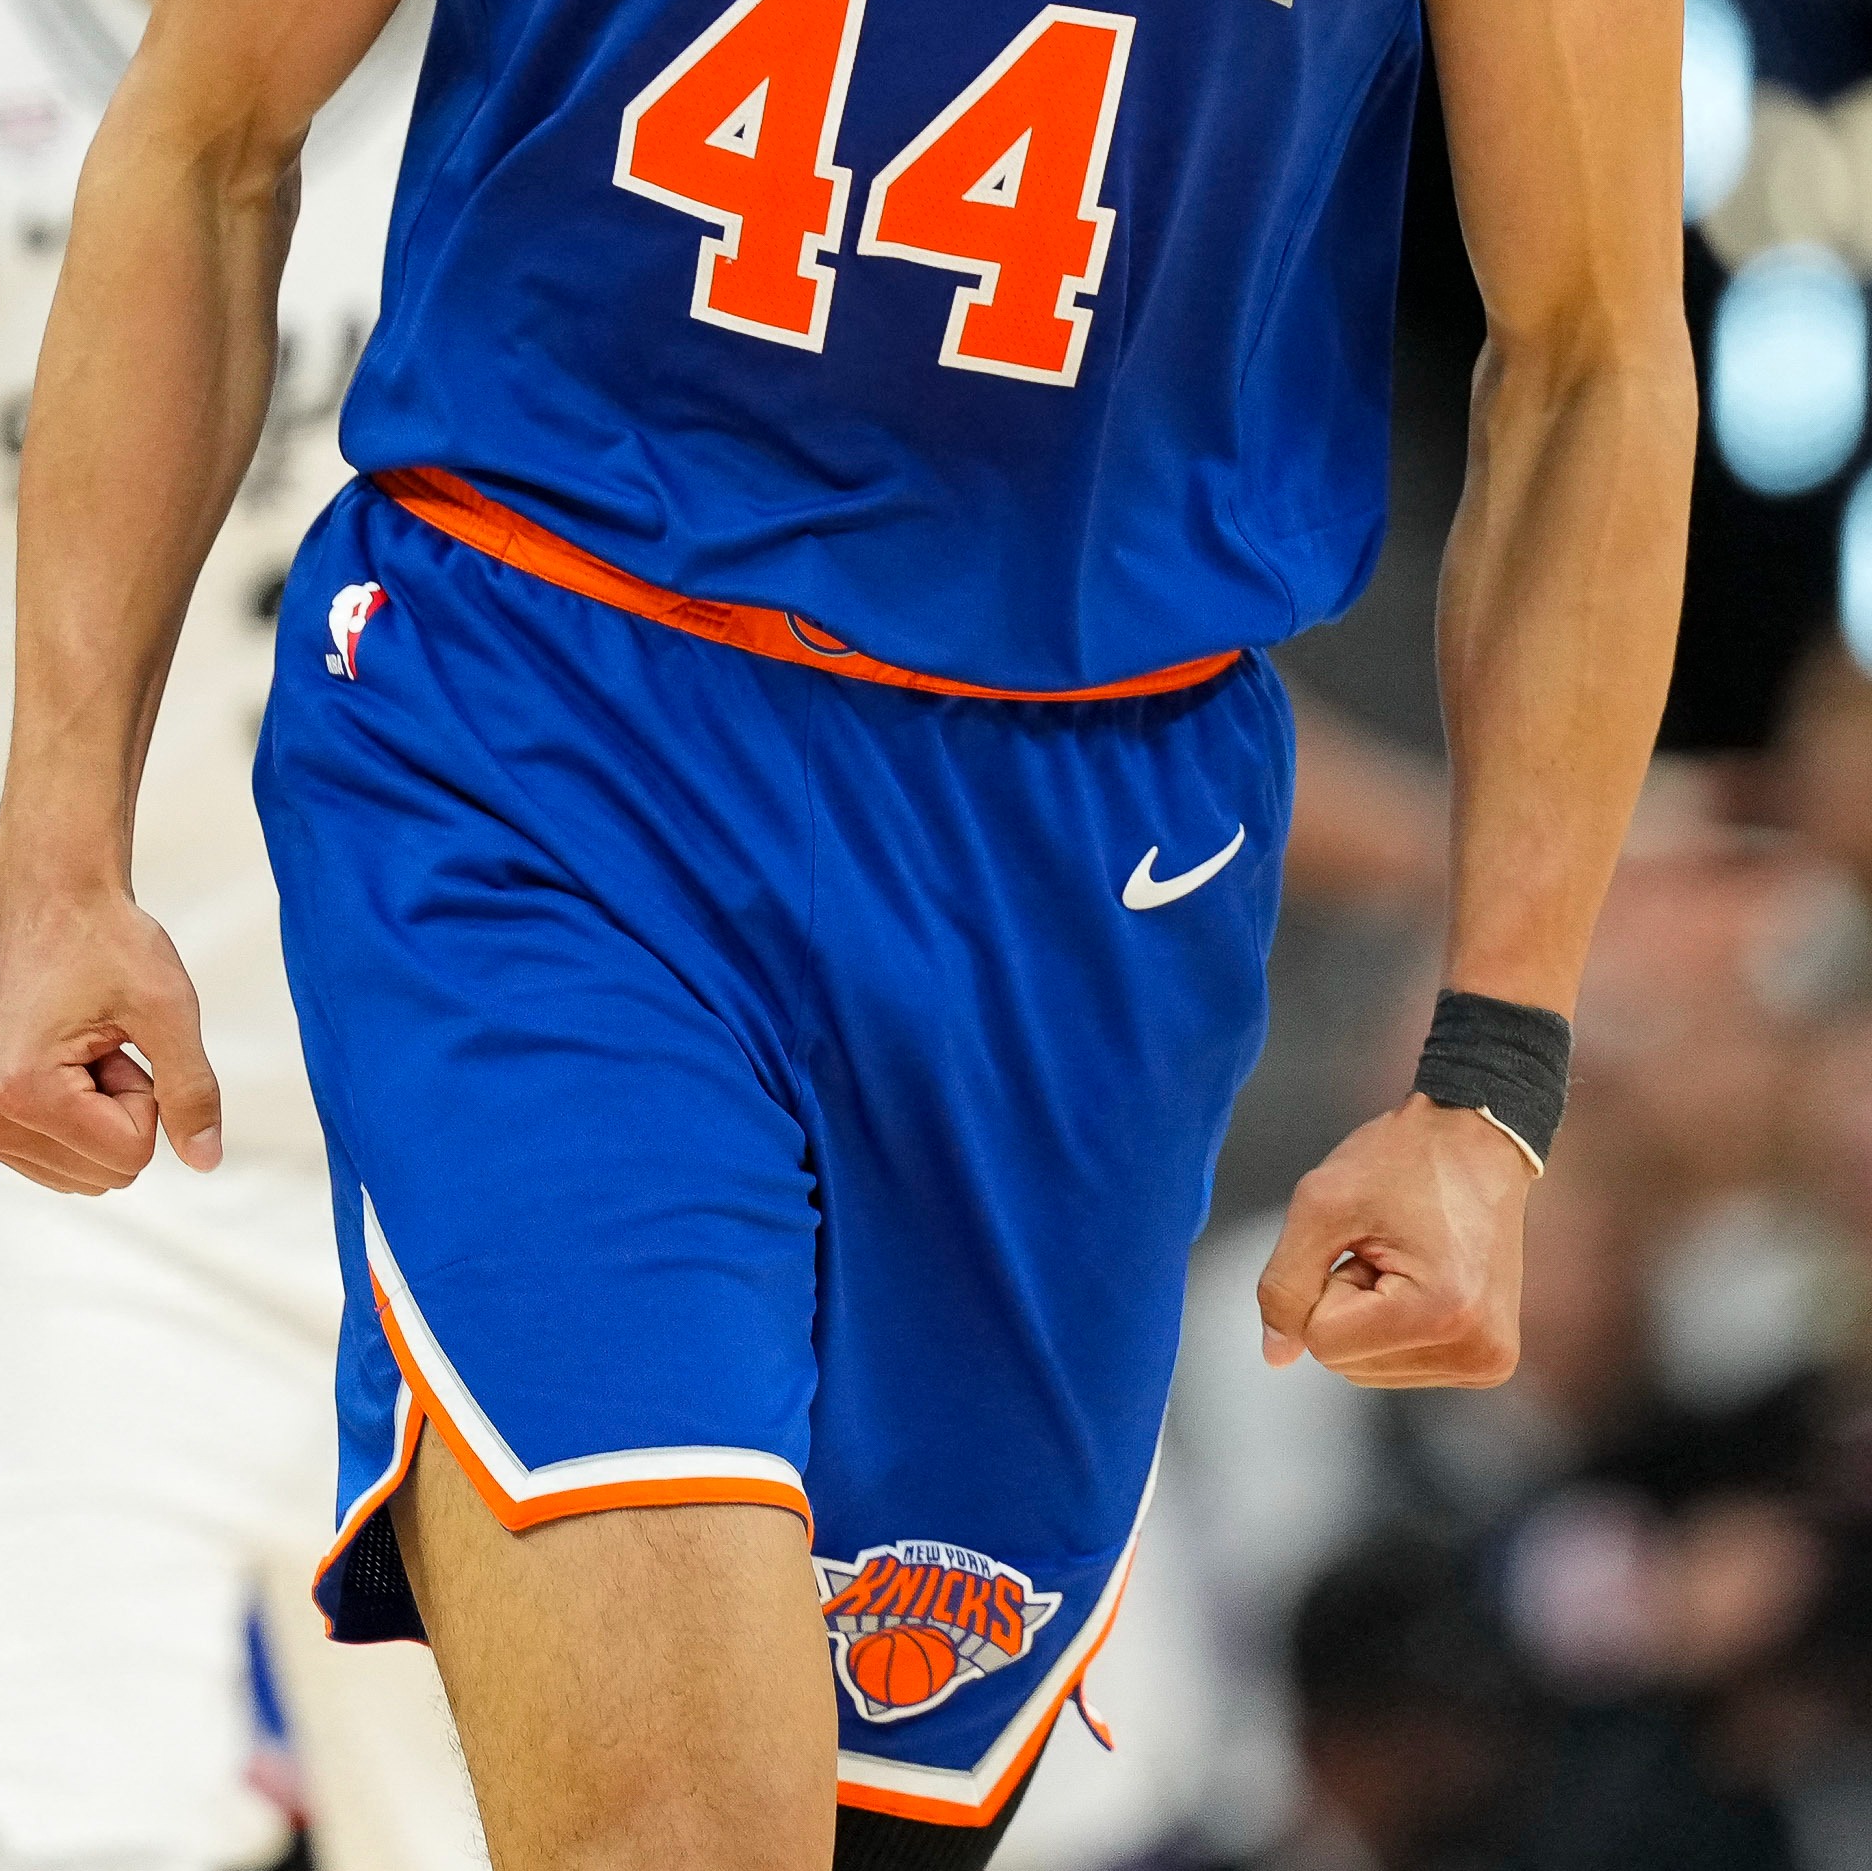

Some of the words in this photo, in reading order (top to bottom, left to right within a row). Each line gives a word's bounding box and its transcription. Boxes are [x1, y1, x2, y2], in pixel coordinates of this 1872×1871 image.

[904, 1545, 940, 1563] NEW
[945, 1547, 991, 1578] YORK
[822, 1556, 1024, 1658] KNICKS
